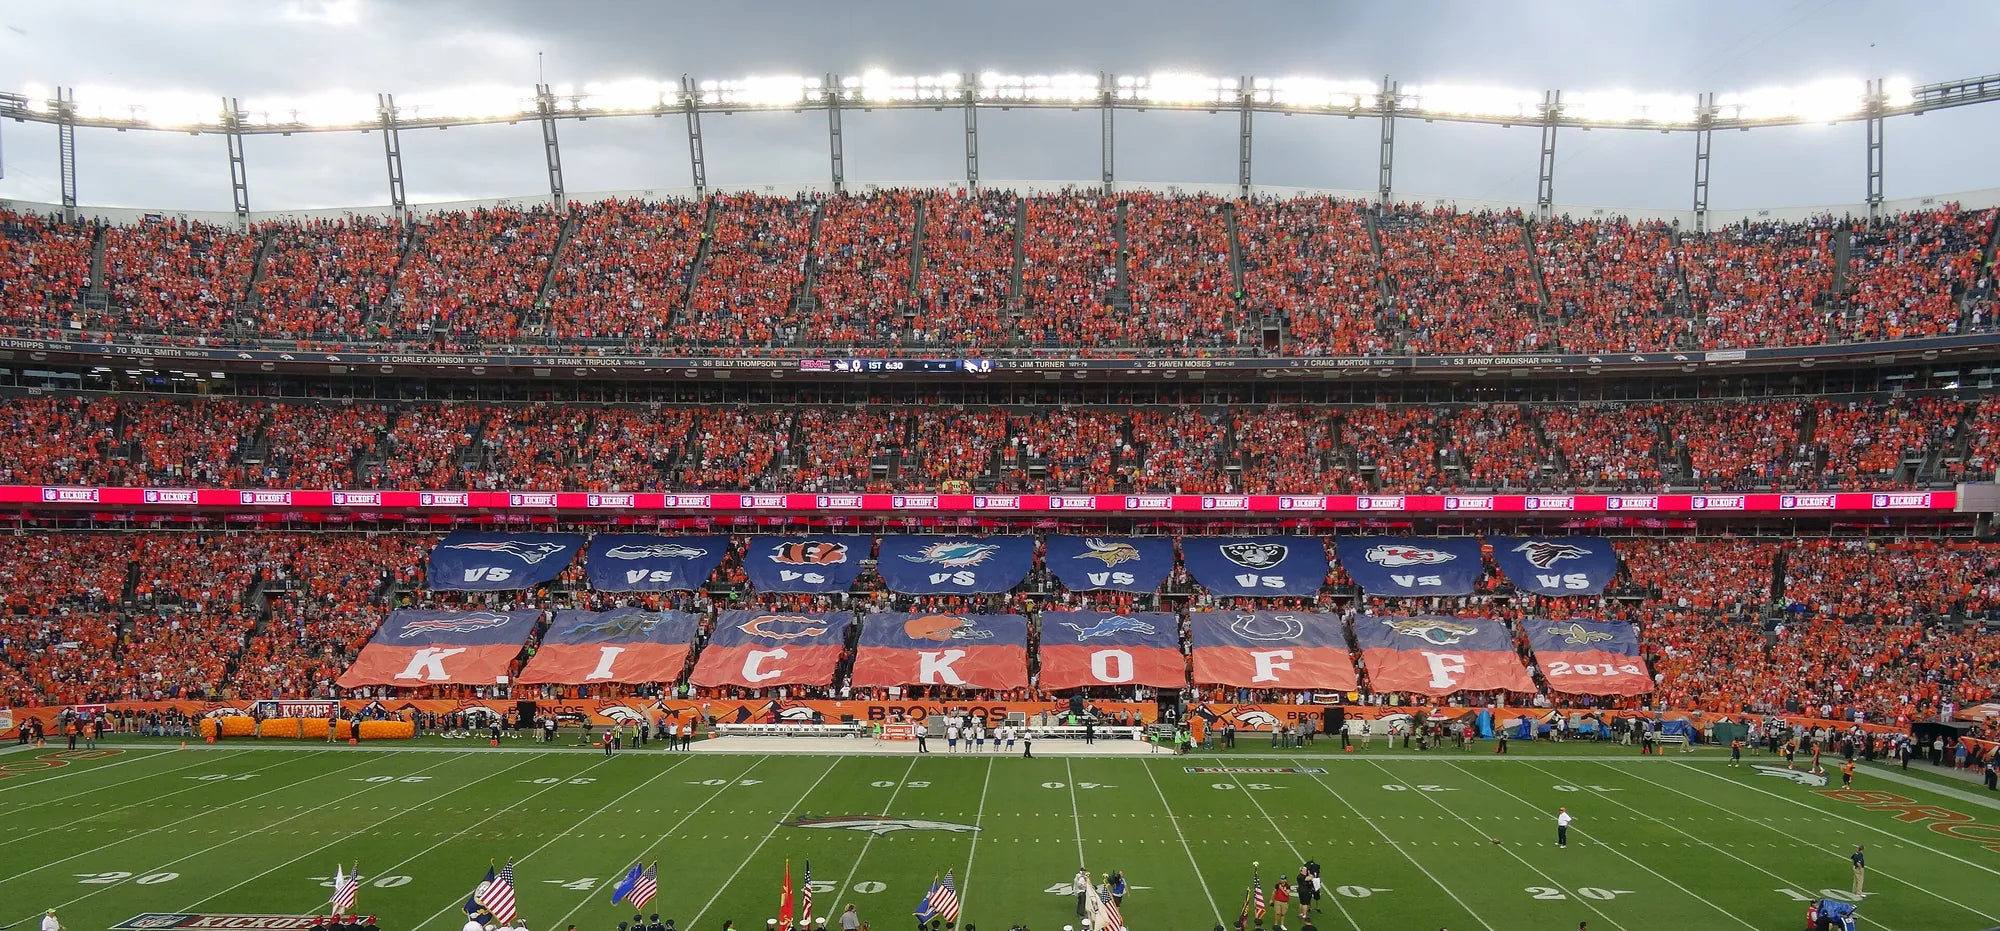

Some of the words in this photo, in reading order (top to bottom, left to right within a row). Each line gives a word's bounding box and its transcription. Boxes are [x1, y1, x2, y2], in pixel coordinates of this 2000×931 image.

[11, 340, 44, 349] PHIPPS
[131, 347, 150, 355] PAUL
[154, 348, 181, 356] SMITH
[801, 360, 830, 368] GMC
[885, 362, 903, 370] 6:30
[1890, 497, 1923, 505] KICKOFF
[394, 647, 466, 680] K
[586, 646, 625, 680] I
[742, 648, 788, 682] C
[918, 649, 966, 685] K
[1091, 649, 1133, 683] O
[1250, 650, 1293, 682] F
[1421, 651, 1465, 688] F
[1548, 661, 1643, 676] 2014
[282, 704, 330, 718] KICKOFF
[508, 705, 584, 715] BNCOS
[1287, 711, 1363, 720] BROOS
[1524, 887, 1616, 900] 20
